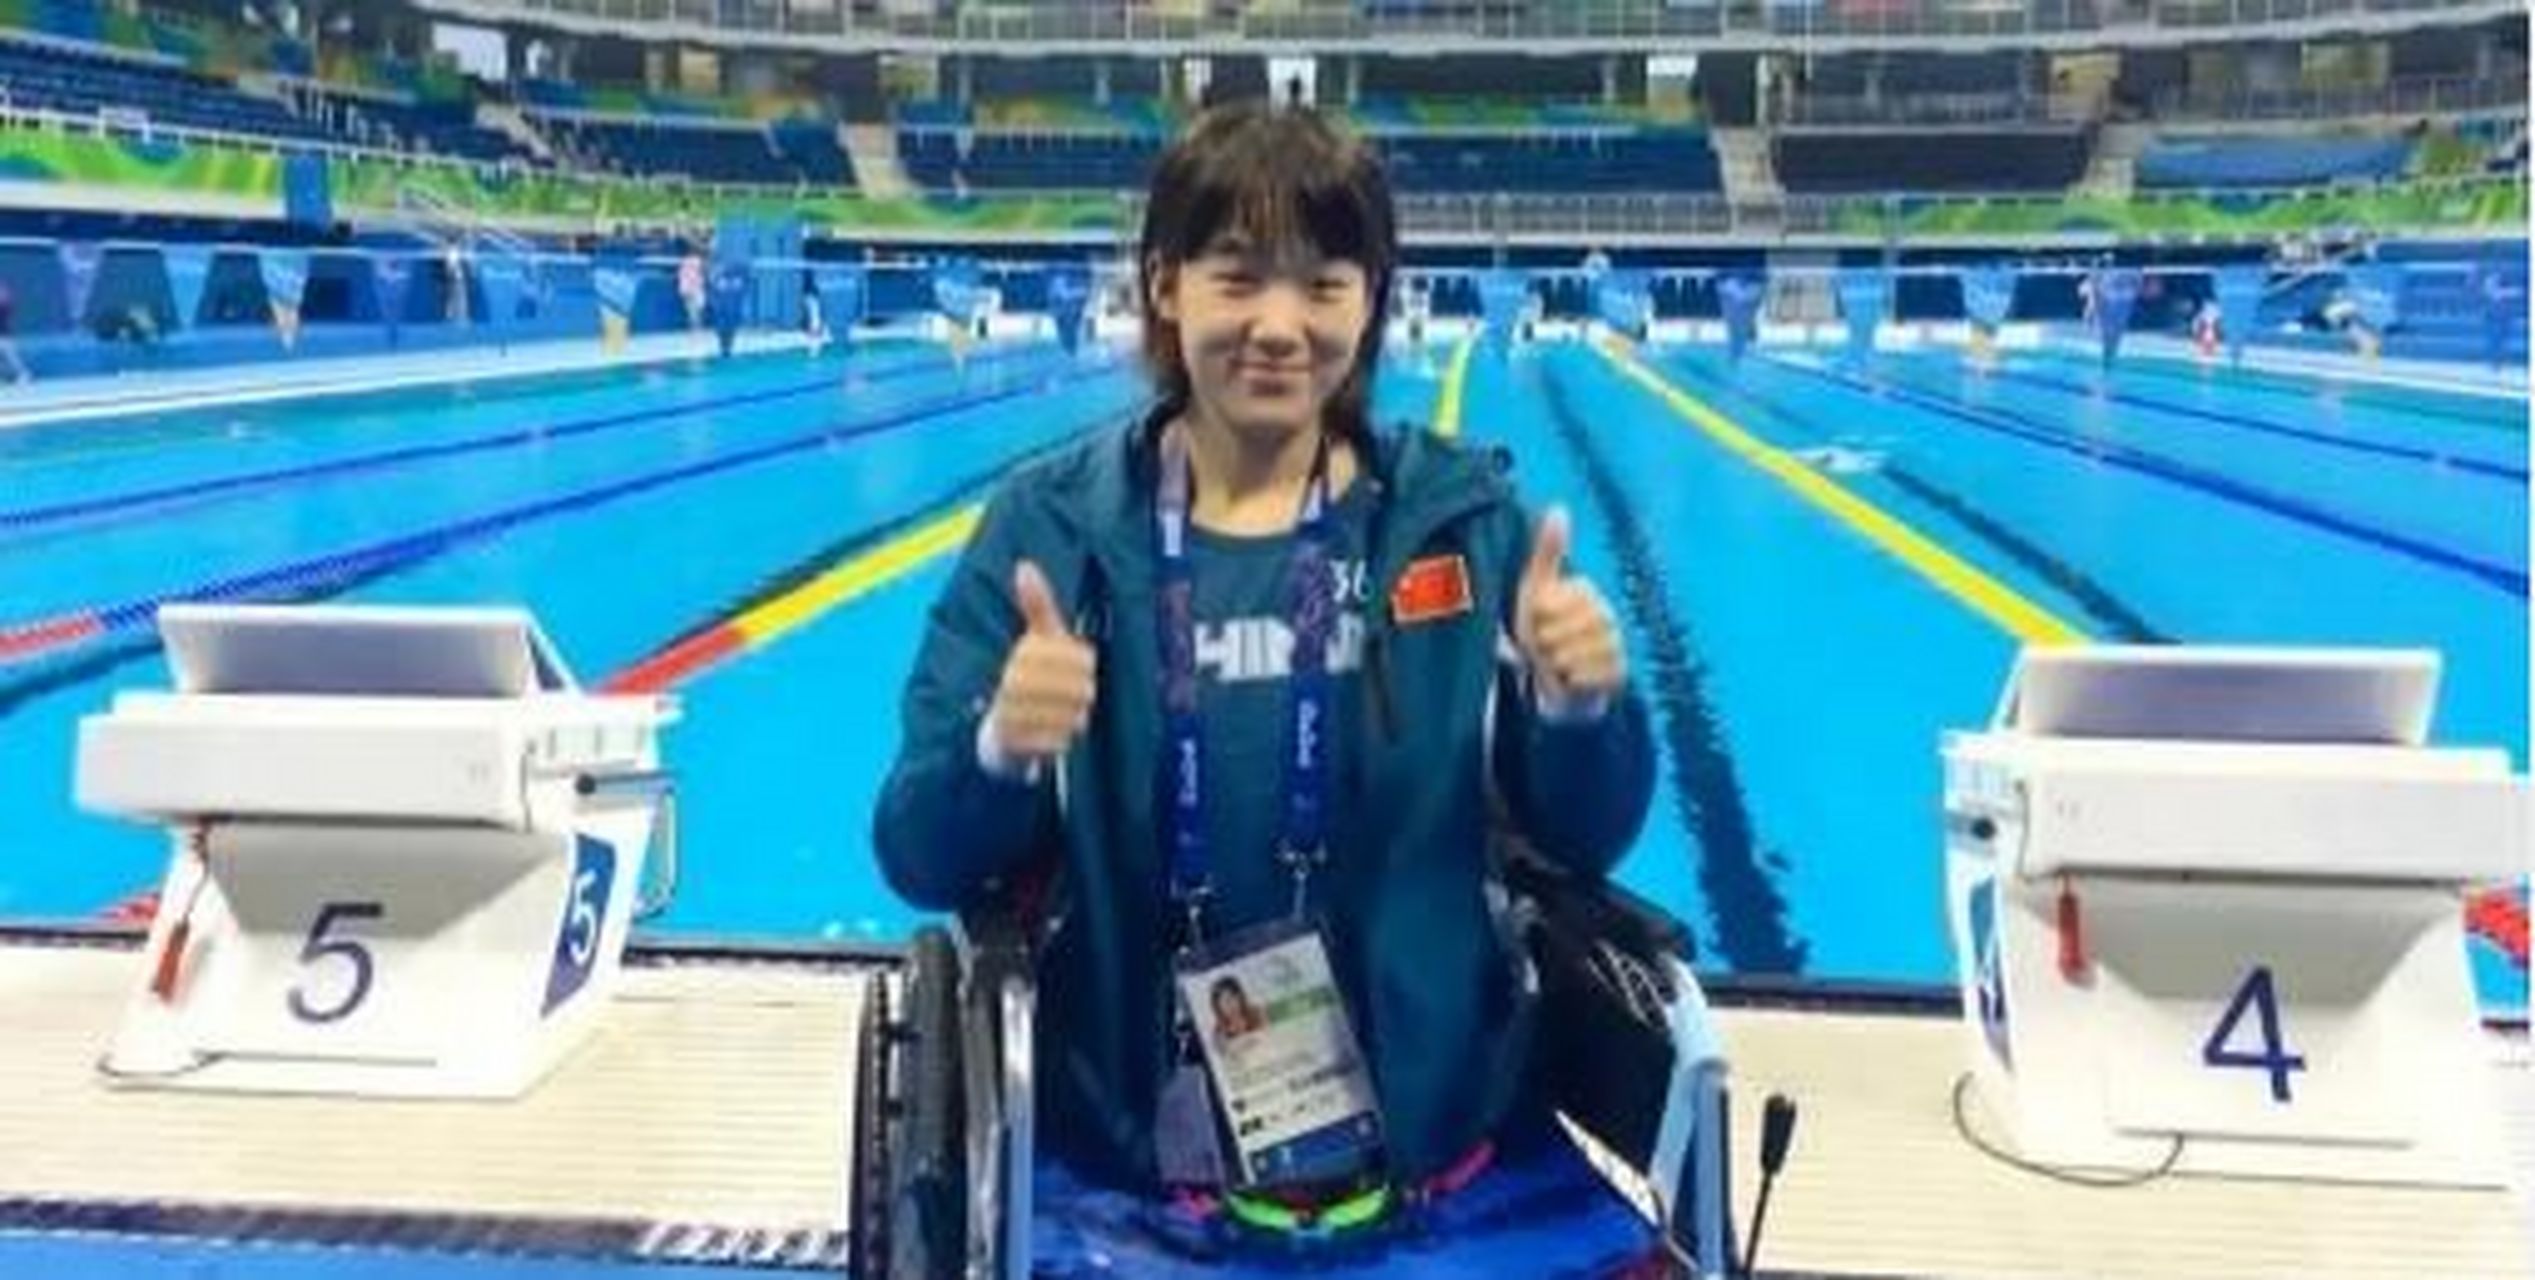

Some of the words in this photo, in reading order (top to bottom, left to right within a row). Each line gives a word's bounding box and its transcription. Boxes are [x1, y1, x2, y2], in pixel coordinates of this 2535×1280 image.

[286, 901, 384, 1024] 5
[569, 867, 598, 966] 5
[2202, 966, 2306, 1102] 4
